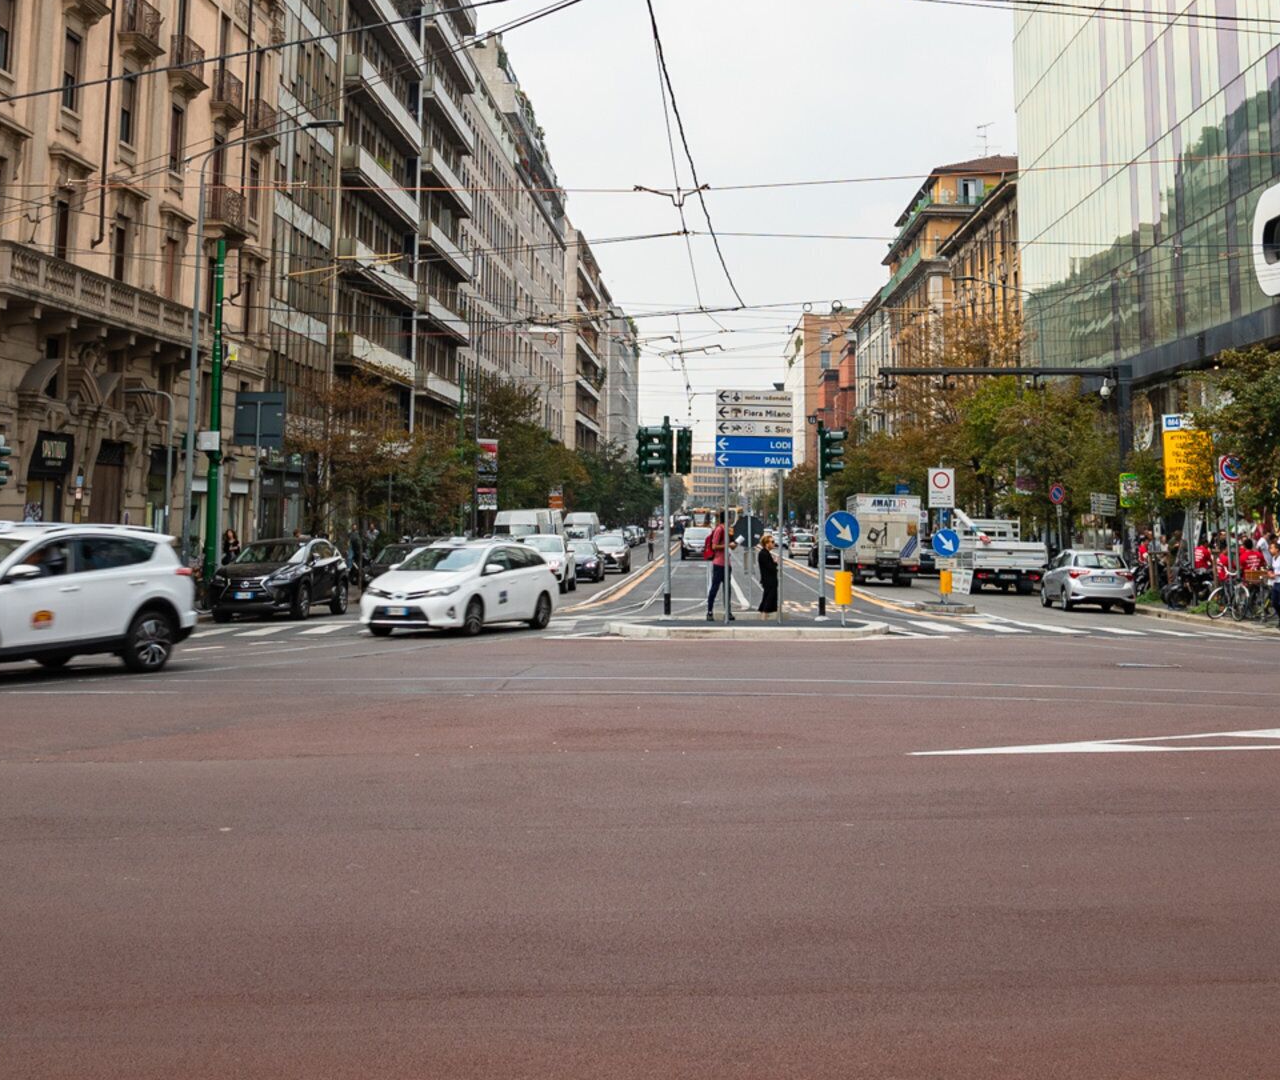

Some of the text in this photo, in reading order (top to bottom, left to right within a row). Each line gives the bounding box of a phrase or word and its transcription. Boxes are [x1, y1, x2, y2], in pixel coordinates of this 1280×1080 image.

[743, 409, 791, 418] Fiera Milano
[770, 441, 791, 449] LODI
[764, 456, 791, 465] PAVIA
